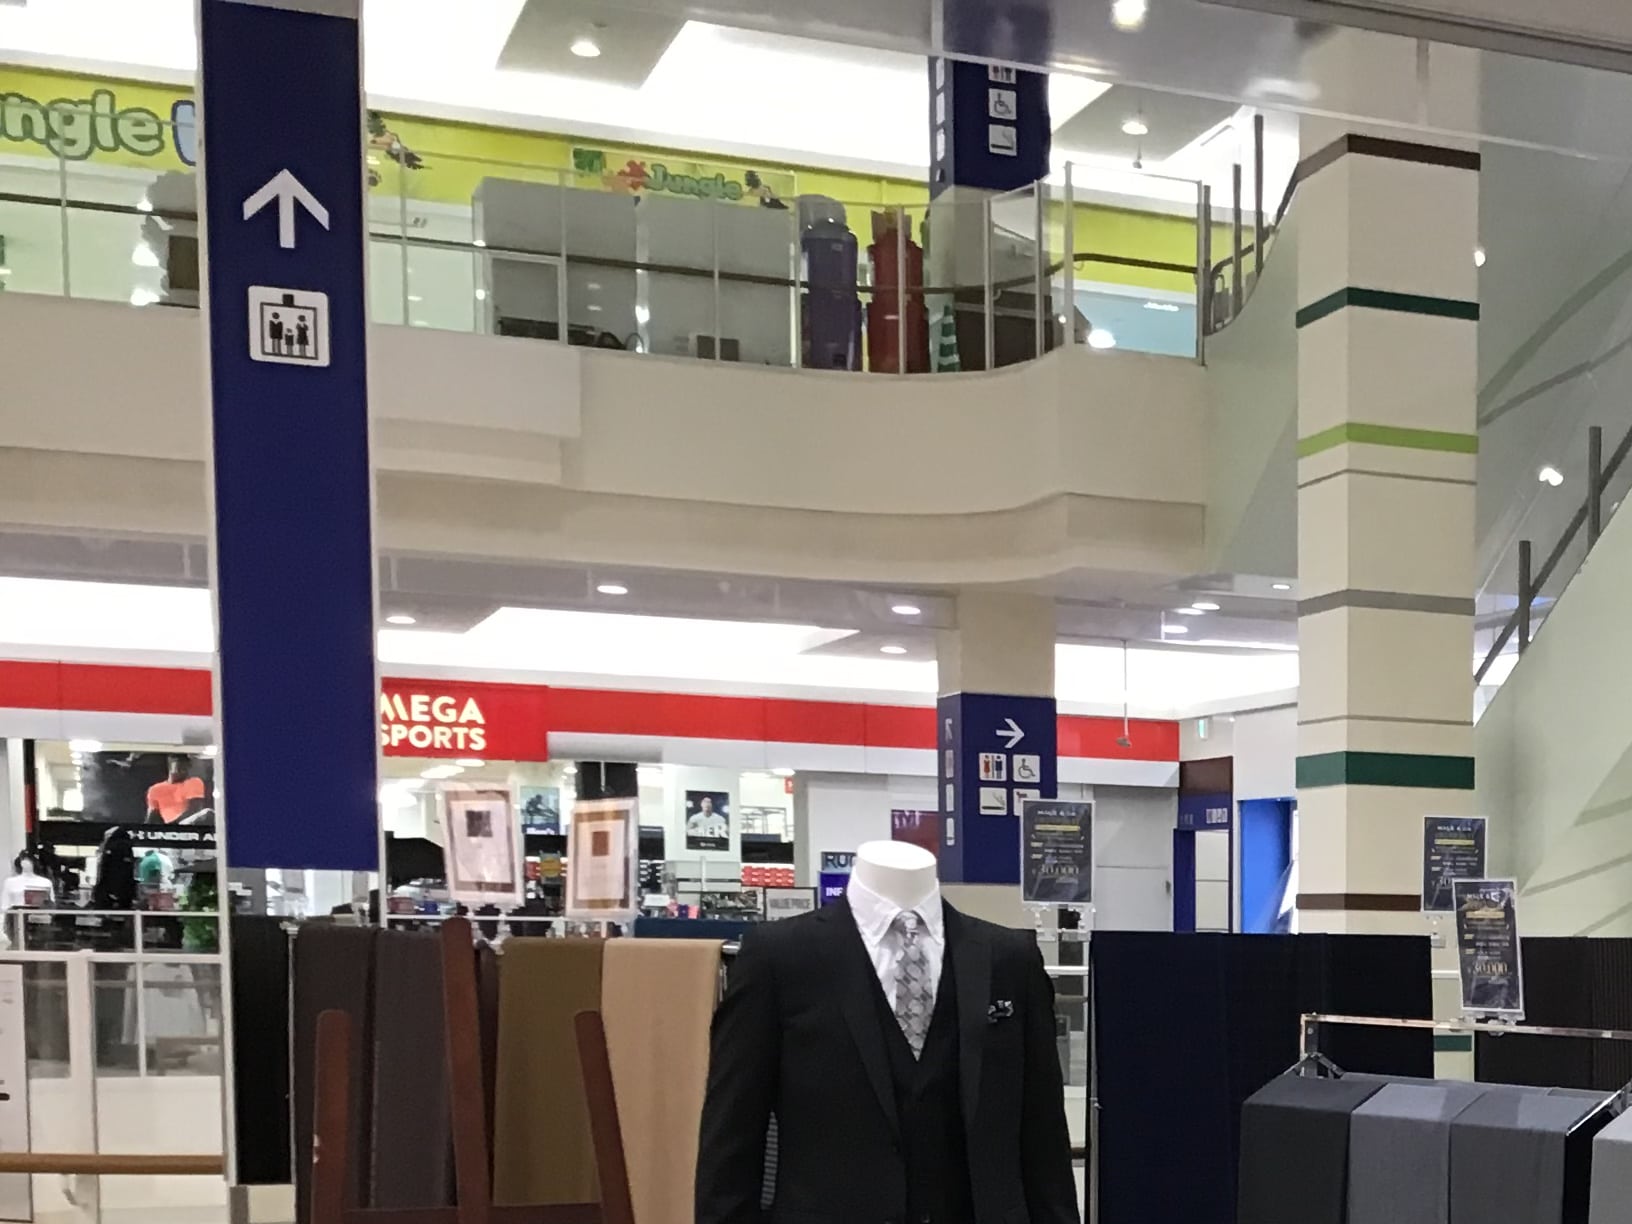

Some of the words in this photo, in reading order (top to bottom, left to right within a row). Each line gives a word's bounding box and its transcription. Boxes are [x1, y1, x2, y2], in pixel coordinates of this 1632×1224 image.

[0, 89, 165, 161] ngle
[643, 163, 743, 201] Jungle
[380, 693, 486, 725] MEGA
[380, 723, 487, 751] SPORTS
[147, 831, 200, 841] UNDER
